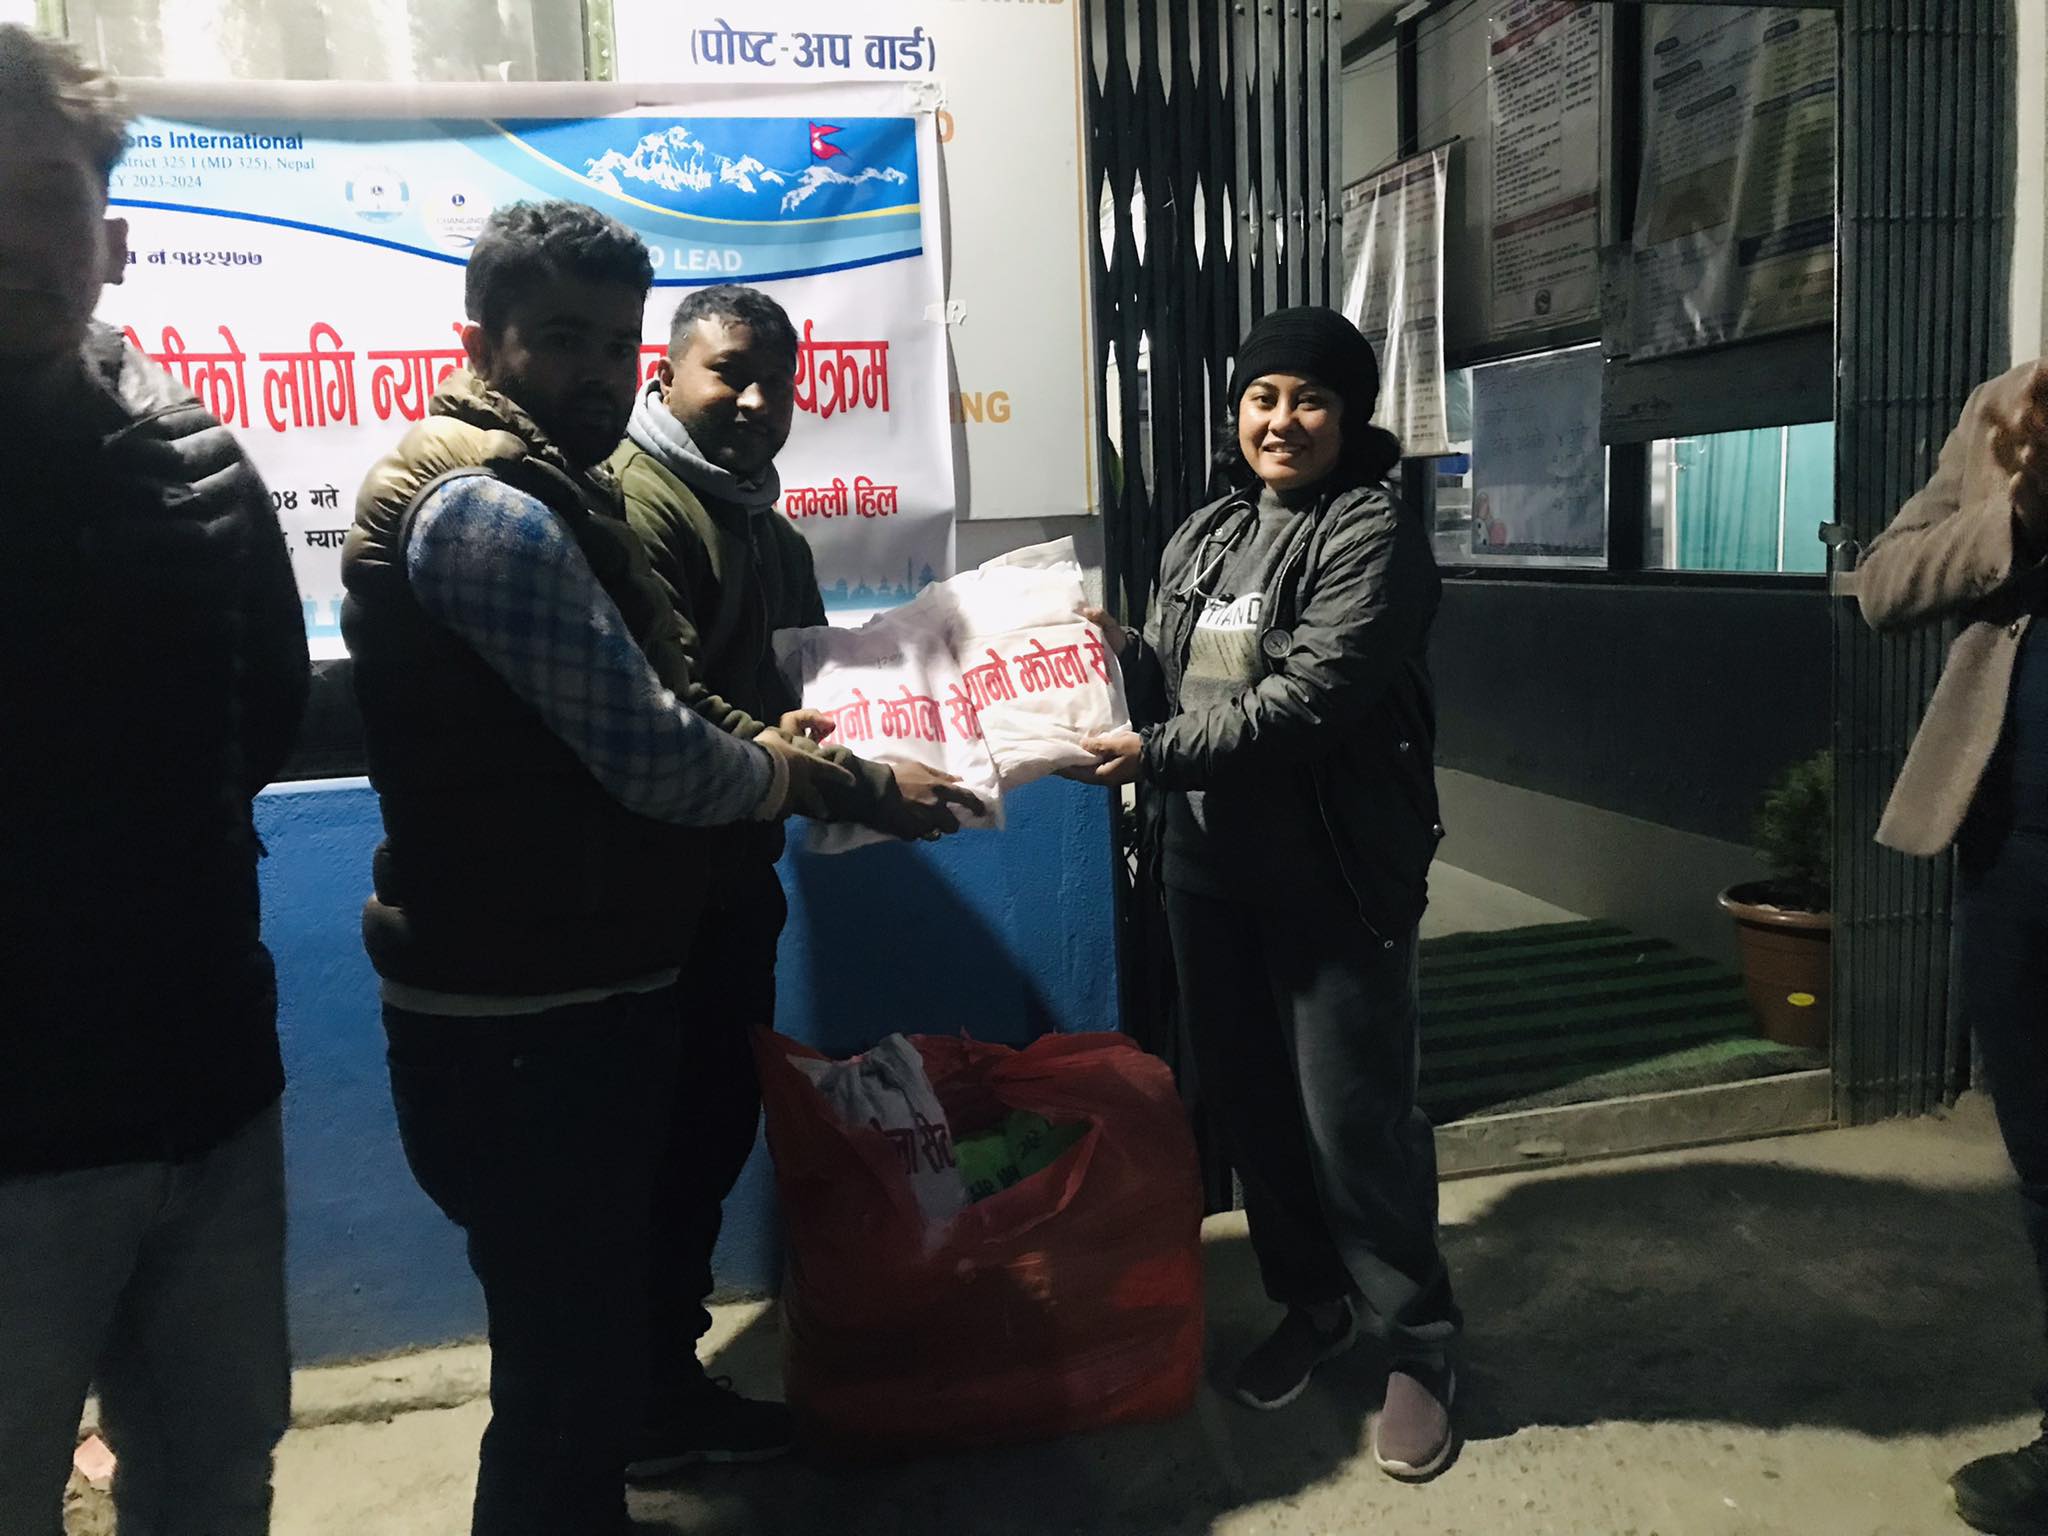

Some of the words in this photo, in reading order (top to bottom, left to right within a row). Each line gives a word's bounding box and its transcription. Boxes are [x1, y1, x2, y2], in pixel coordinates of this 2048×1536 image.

[864, 26, 936, 72] वार्ड)
[169, 132, 304, 150] International
[133, 175, 203, 188] 2023-2024
[276, 157, 316, 171] Nepal
[674, 247, 743, 272] LEAD
[259, 322, 358, 432] लागि
[309, 484, 340, 510] गते
[854, 475, 898, 519] हिल
[1013, 638, 1089, 694] झोला
[878, 684, 947, 744] झोला
